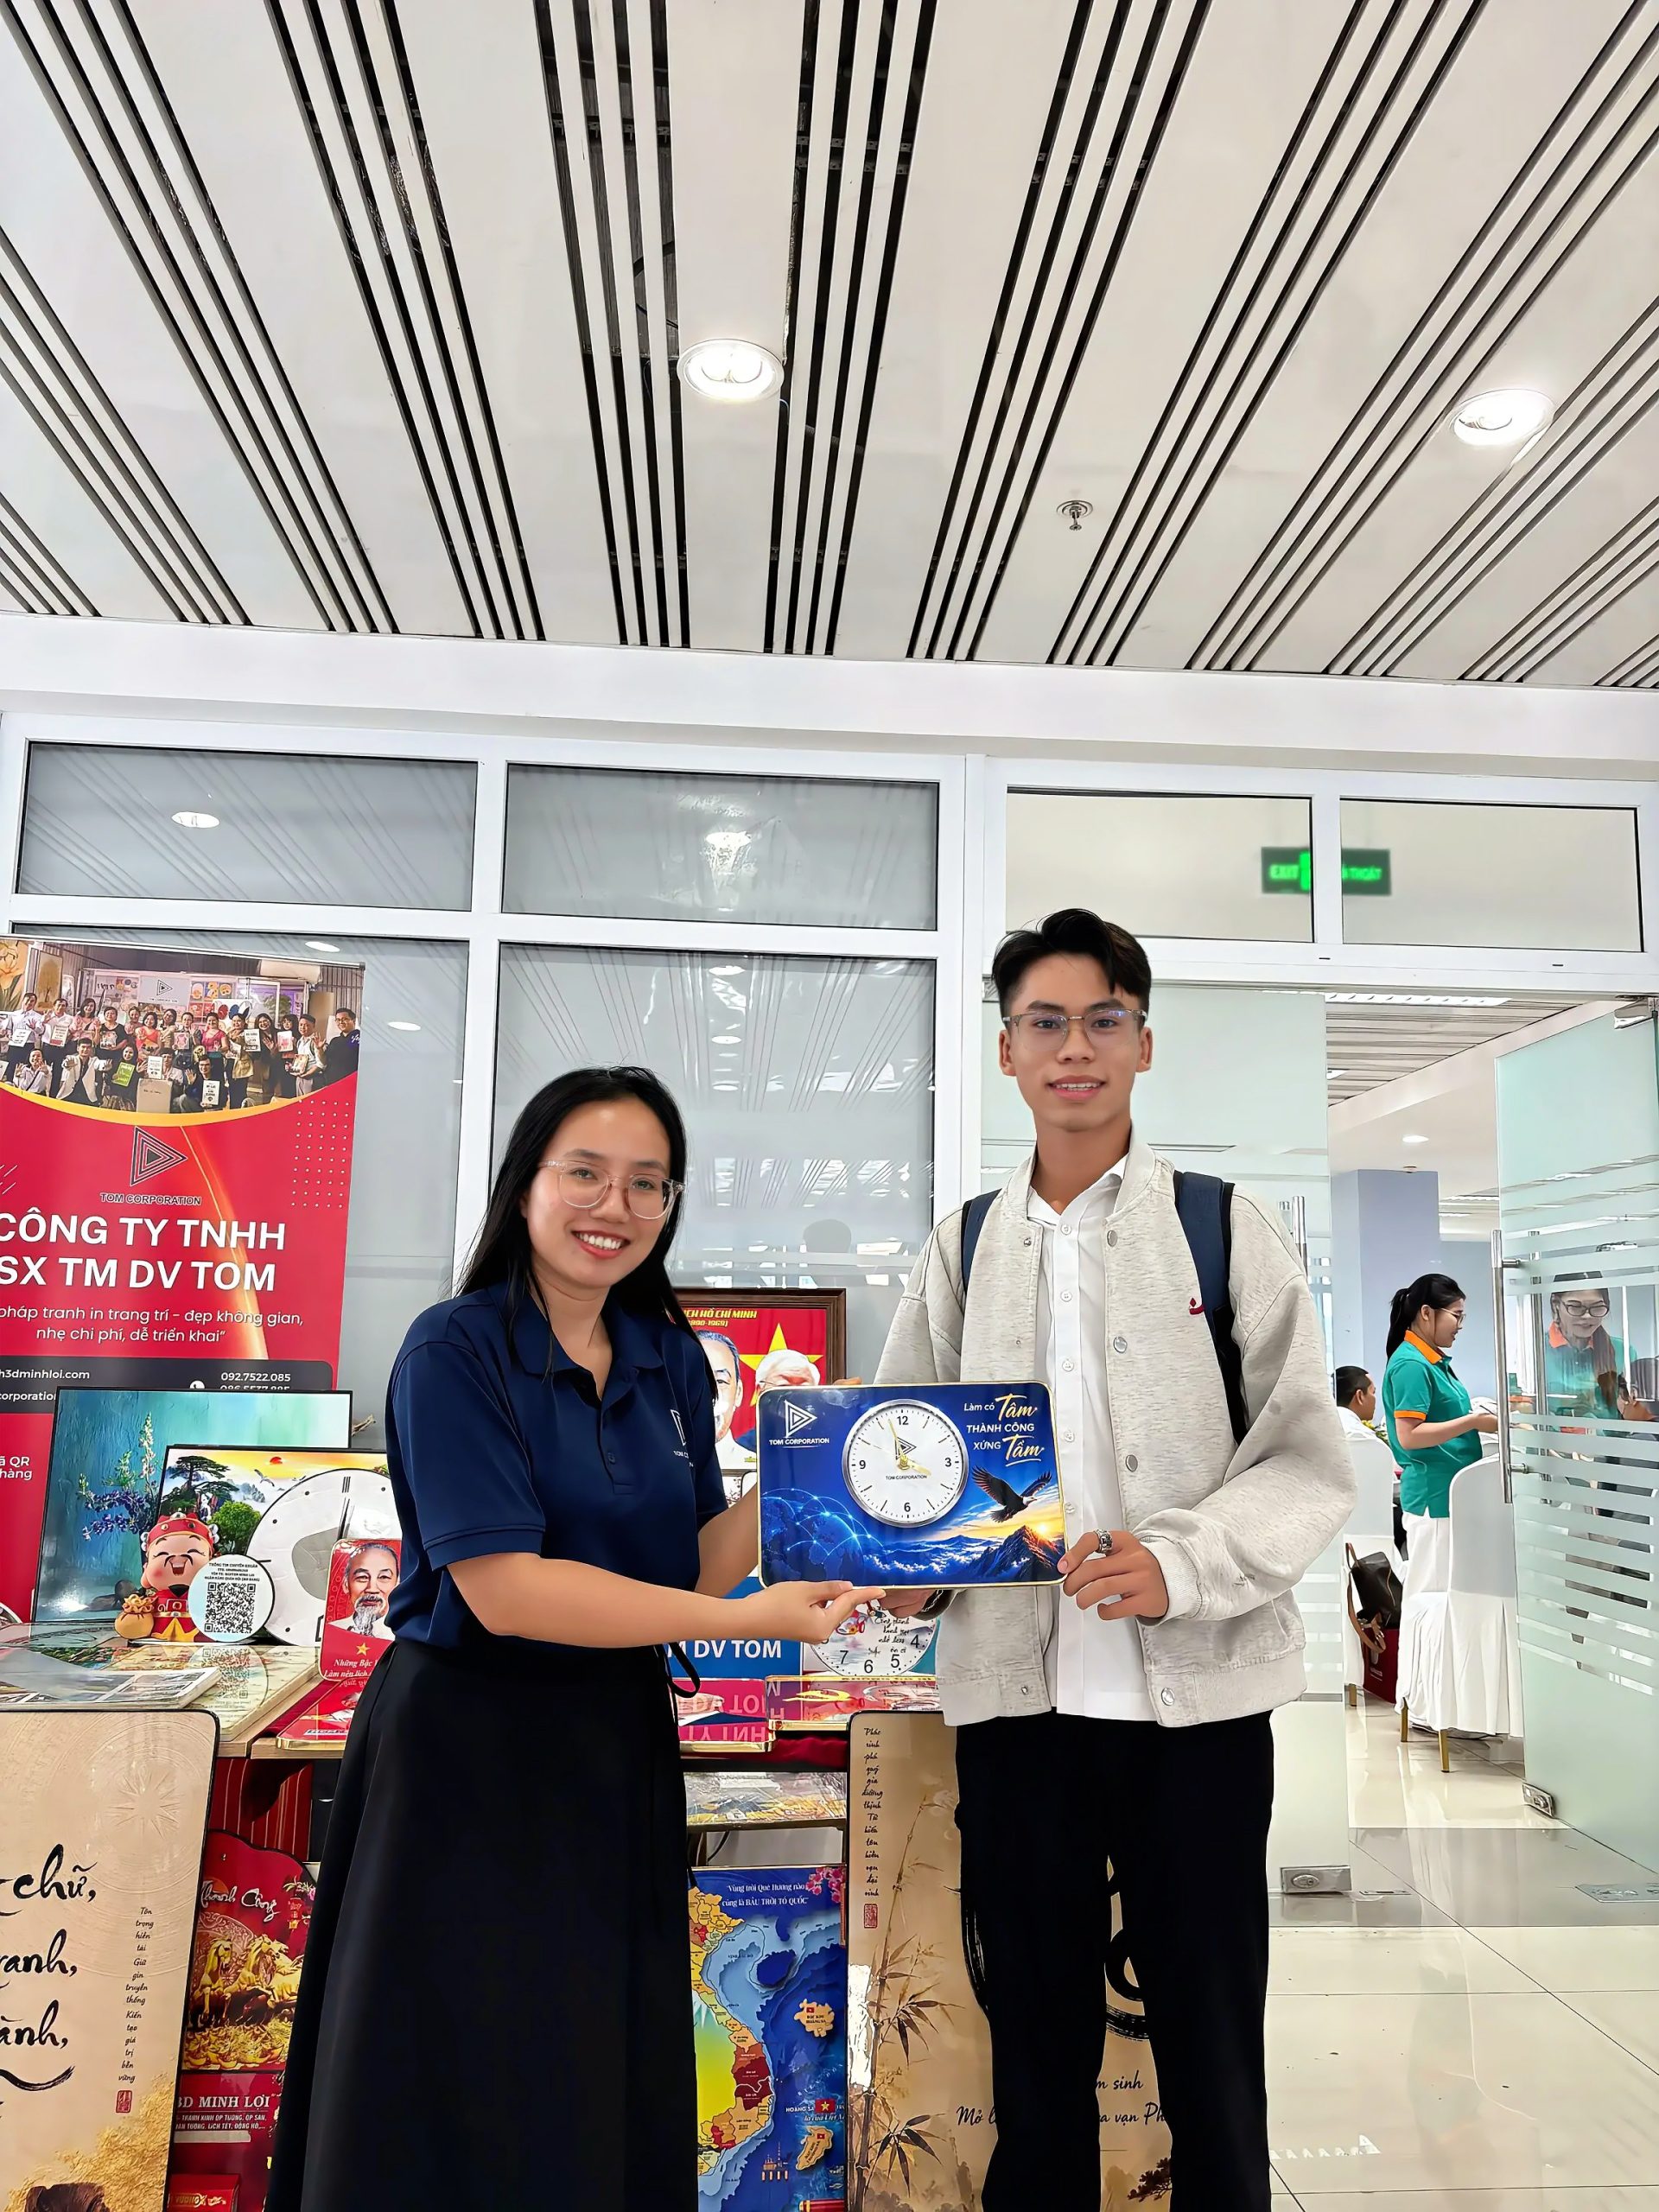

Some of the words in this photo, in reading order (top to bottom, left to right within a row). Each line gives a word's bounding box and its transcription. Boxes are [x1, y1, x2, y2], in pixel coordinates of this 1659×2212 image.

[100, 1192, 124, 1203] TOM
[127, 1193, 201, 1205] CORPORATION
[0, 1206, 108, 1244] CÔNG
[119, 1217, 168, 1246] TY
[177, 1219, 285, 1250] TNHH
[0, 1255, 48, 1285] SX
[59, 1257, 118, 1287] TM
[130, 1260, 182, 1289] DV
[191, 1261, 276, 1291] TOM
[43, 1307, 85, 1319] tranh
[91, 1307, 104, 1319] in
[109, 1309, 149, 1325] trang
[154, 1309, 168, 1321] trí
[185, 1310, 213, 1325] đẹp
[217, 1311, 263, 1327] không
[267, 1312, 303, 1326] gian,
[36, 1327, 66, 1341] nhẹ
[70, 1328, 94, 1339] chi
[99, 1328, 125, 1344] phí,
[130, 1327, 149, 1341] dễ
[153, 1327, 185, 1341] triển
[221, 1372, 291, 1382] 092.7522.085
[0, 1391, 56, 1402] orporatio
[964, 1402, 982, 1411] Làm
[995, 1393, 1038, 1421] Tâm
[897, 1415, 909, 1426] 12
[967, 1422, 1001, 1433] THÀNH
[1004, 1422, 1034, 1432] CÔNG
[973, 1440, 1001, 1450] XỨNG
[1002, 1434, 1045, 1460] Tầm
[10, 1456, 29, 1467] QR
[859, 1460, 866, 1469] 9
[944, 1458, 951, 1466] 3
[904, 1502, 911, 1512] 6
[694, 1640, 727, 1658] DV
[731, 1640, 781, 1658] TOM
[910, 1635, 919, 1648] 4
[840, 1649, 849, 1664] 7
[891, 1654, 899, 1668] 5
[864, 1659, 874, 1674] 6
[1113, 2070, 1143, 2089] sinh
[199, 2096, 239, 2107] MINH
[245, 2094, 270, 2110] LỢI
[956, 2106, 983, 2126] Mở
[1115, 2114, 1138, 2126] vạn
